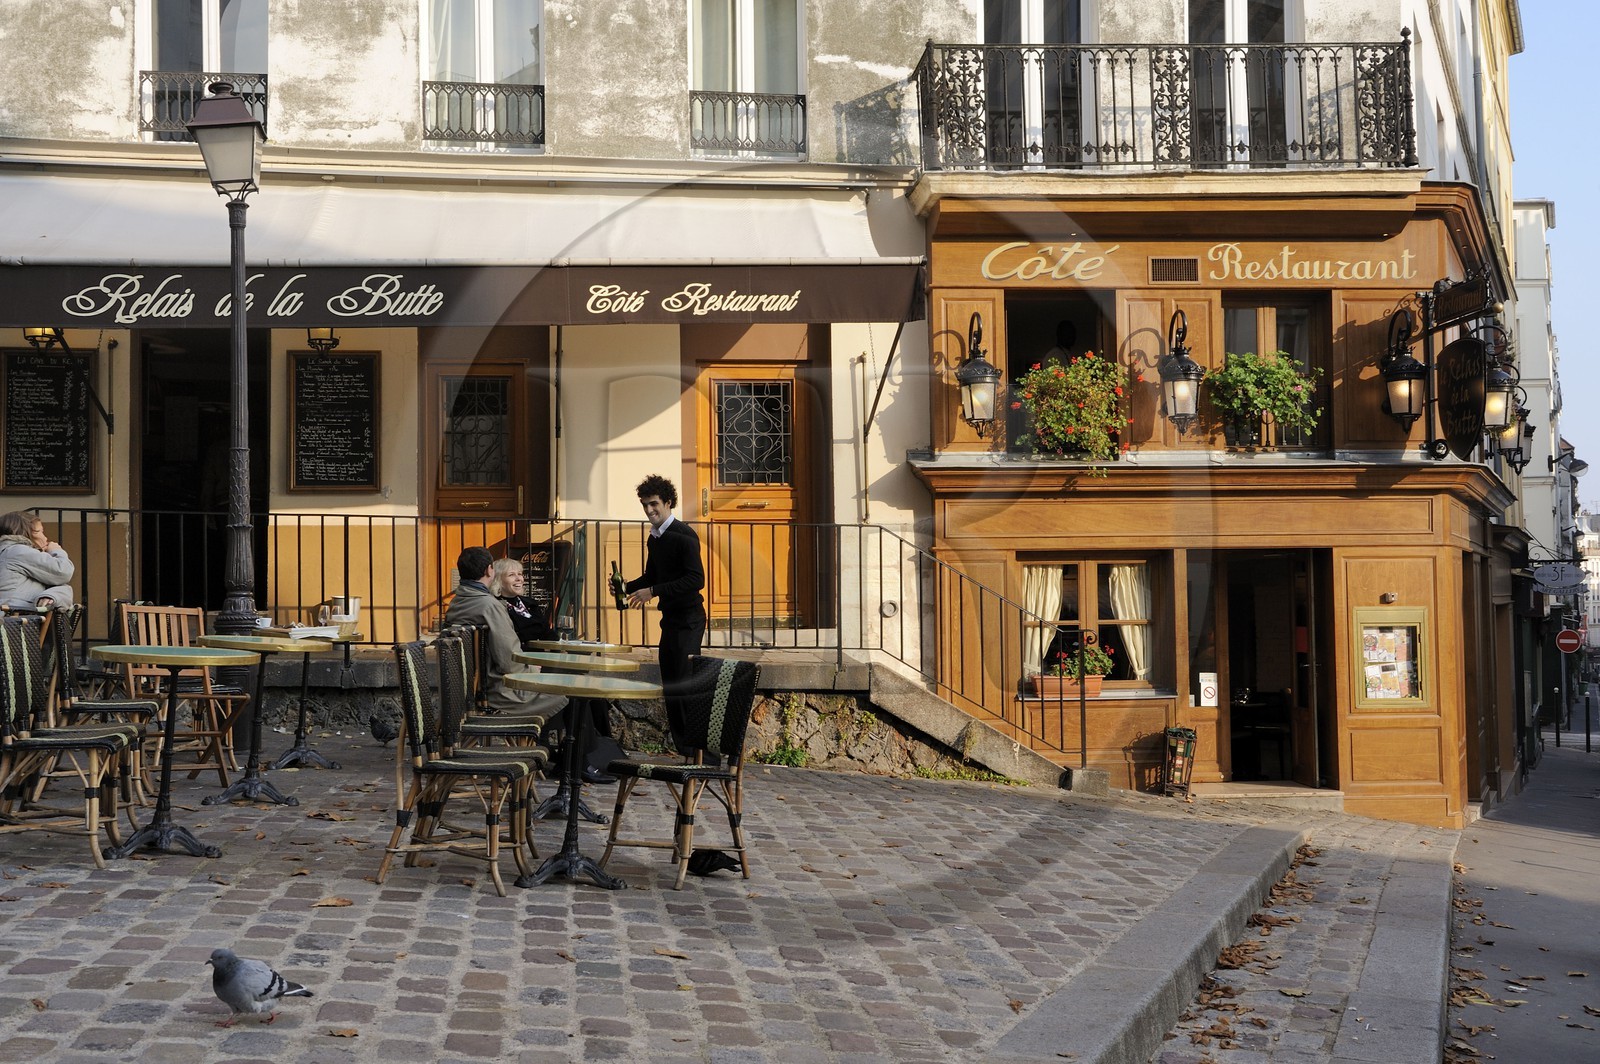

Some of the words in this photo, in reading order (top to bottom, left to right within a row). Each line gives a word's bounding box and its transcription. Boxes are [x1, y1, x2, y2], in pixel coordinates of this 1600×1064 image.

[981, 241, 1120, 280] Côté
[1207, 242, 1417, 280] Restaurant
[62, 273, 195, 323] Relais
[266, 273, 307, 317] la
[326, 273, 444, 317] Butte
[586, 284, 650, 314] Côté
[661, 283, 802, 316] Restaurant
[1448, 350, 1481, 386] Relais
[1446, 409, 1478, 438] Butte
[521, 551, 550, 563] CoaCola
[1551, 566, 1566, 582] 3F
